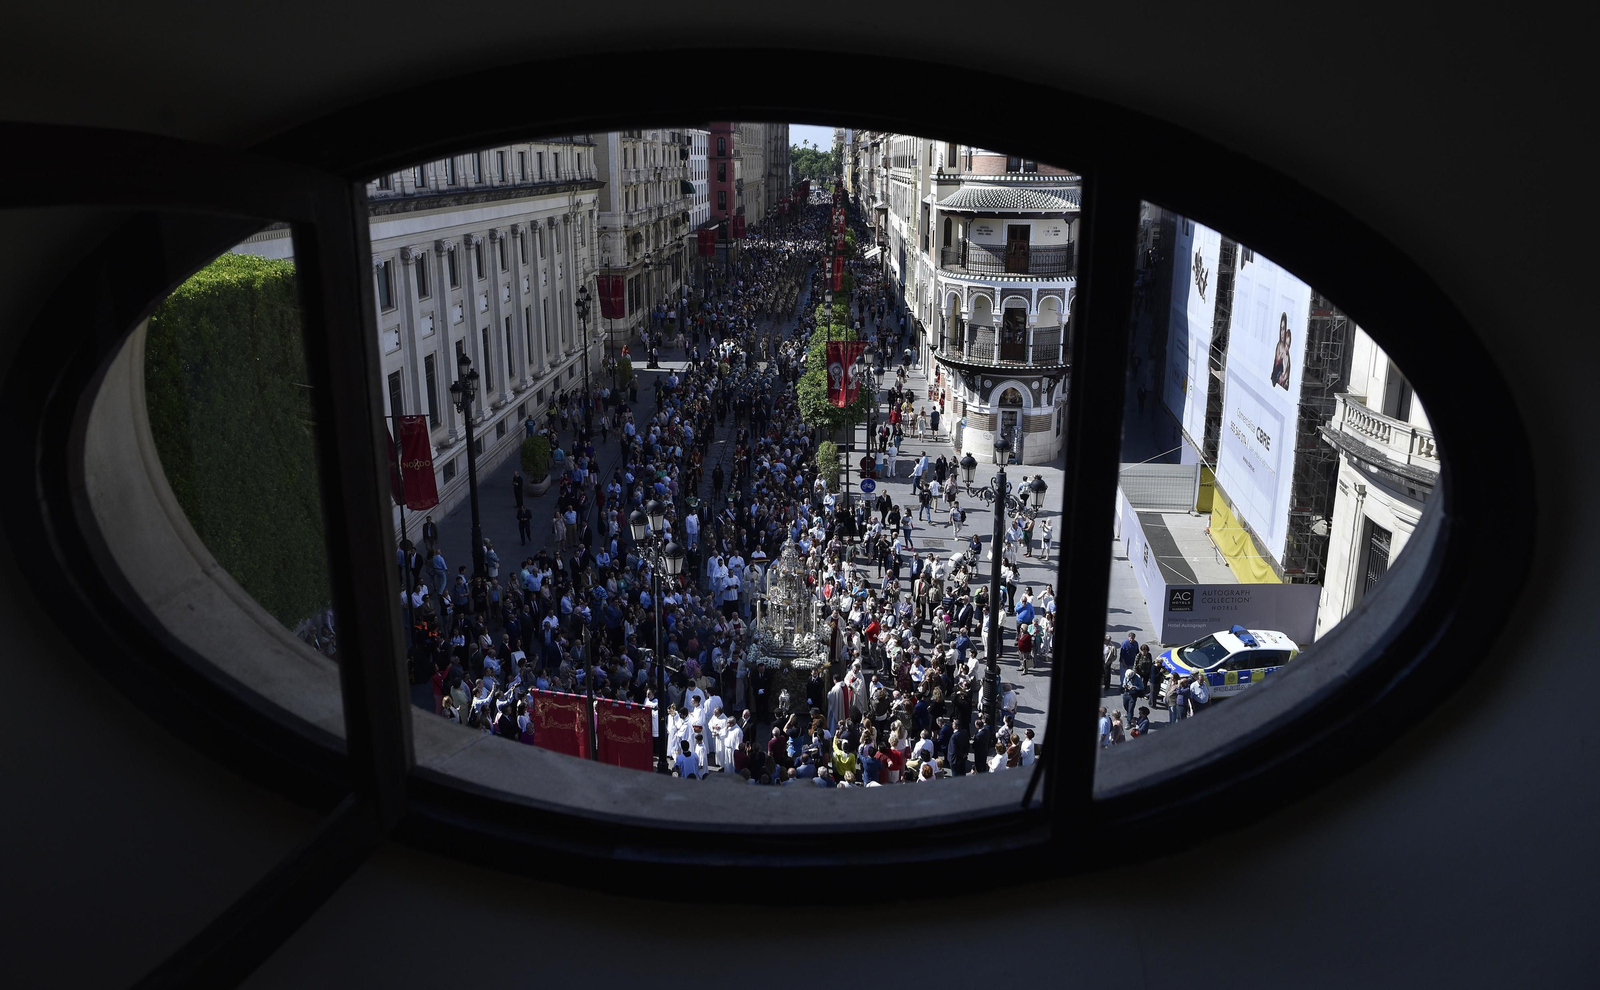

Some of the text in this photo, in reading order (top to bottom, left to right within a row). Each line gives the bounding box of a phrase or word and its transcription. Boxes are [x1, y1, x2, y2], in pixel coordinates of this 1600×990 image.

[1255, 426, 1271, 452] CBRE
[1172, 592, 1192, 601] AC
[1202, 589, 1251, 597] AUTOGRAPH
